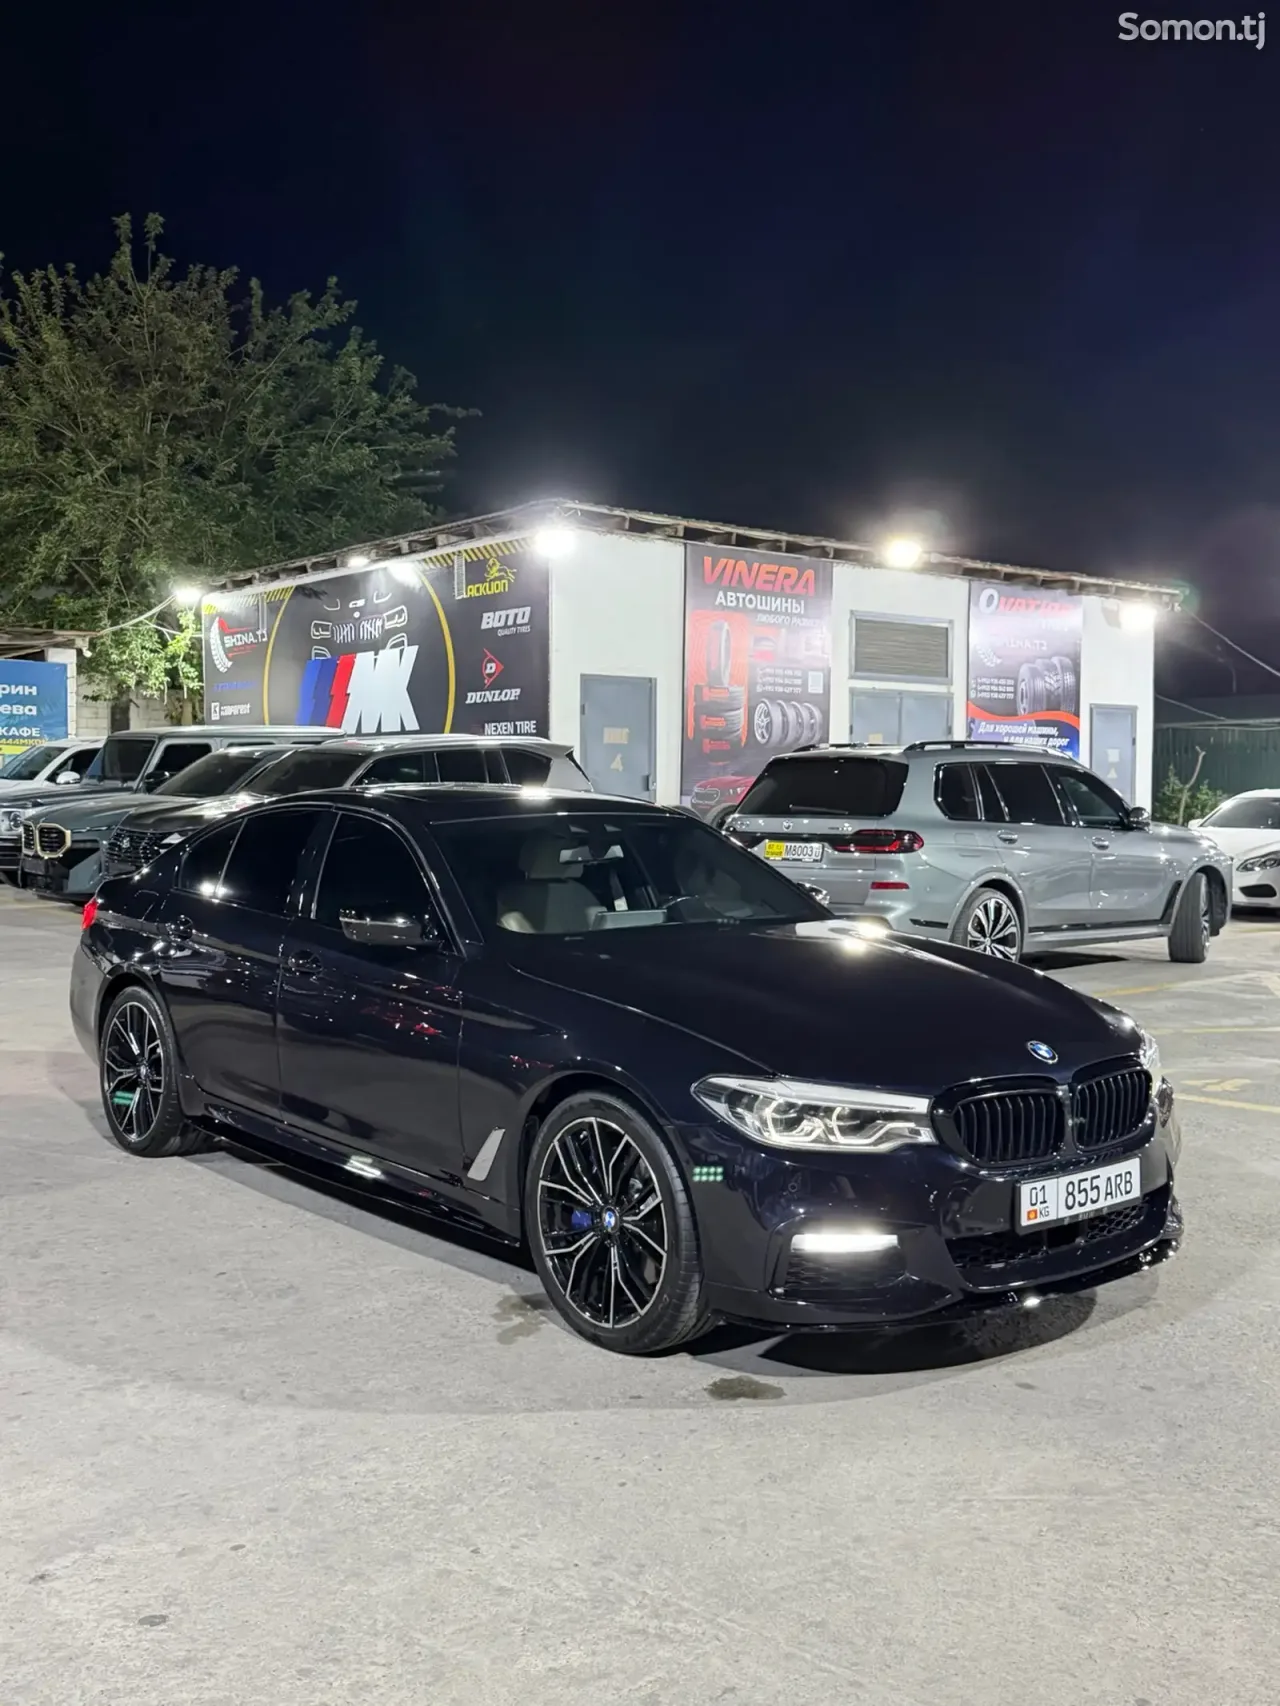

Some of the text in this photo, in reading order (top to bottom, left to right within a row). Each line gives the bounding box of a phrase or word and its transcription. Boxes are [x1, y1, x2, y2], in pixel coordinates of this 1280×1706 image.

[703, 556, 816, 597] VINERA
[463, 579, 508, 598] ACKLION
[715, 591, 805, 615] АВТОШИНЫ
[481, 606, 531, 630] BOTO
[465, 688, 521, 705] DUNLOP
[0, 704, 38, 716] ева
[0, 727, 41, 737] КАФЕ
[484, 720, 536, 735] NEXEN TIRE
[1029, 1170, 1133, 1211] 01 855 ARB
[1039, 1206, 1050, 1219] KG
